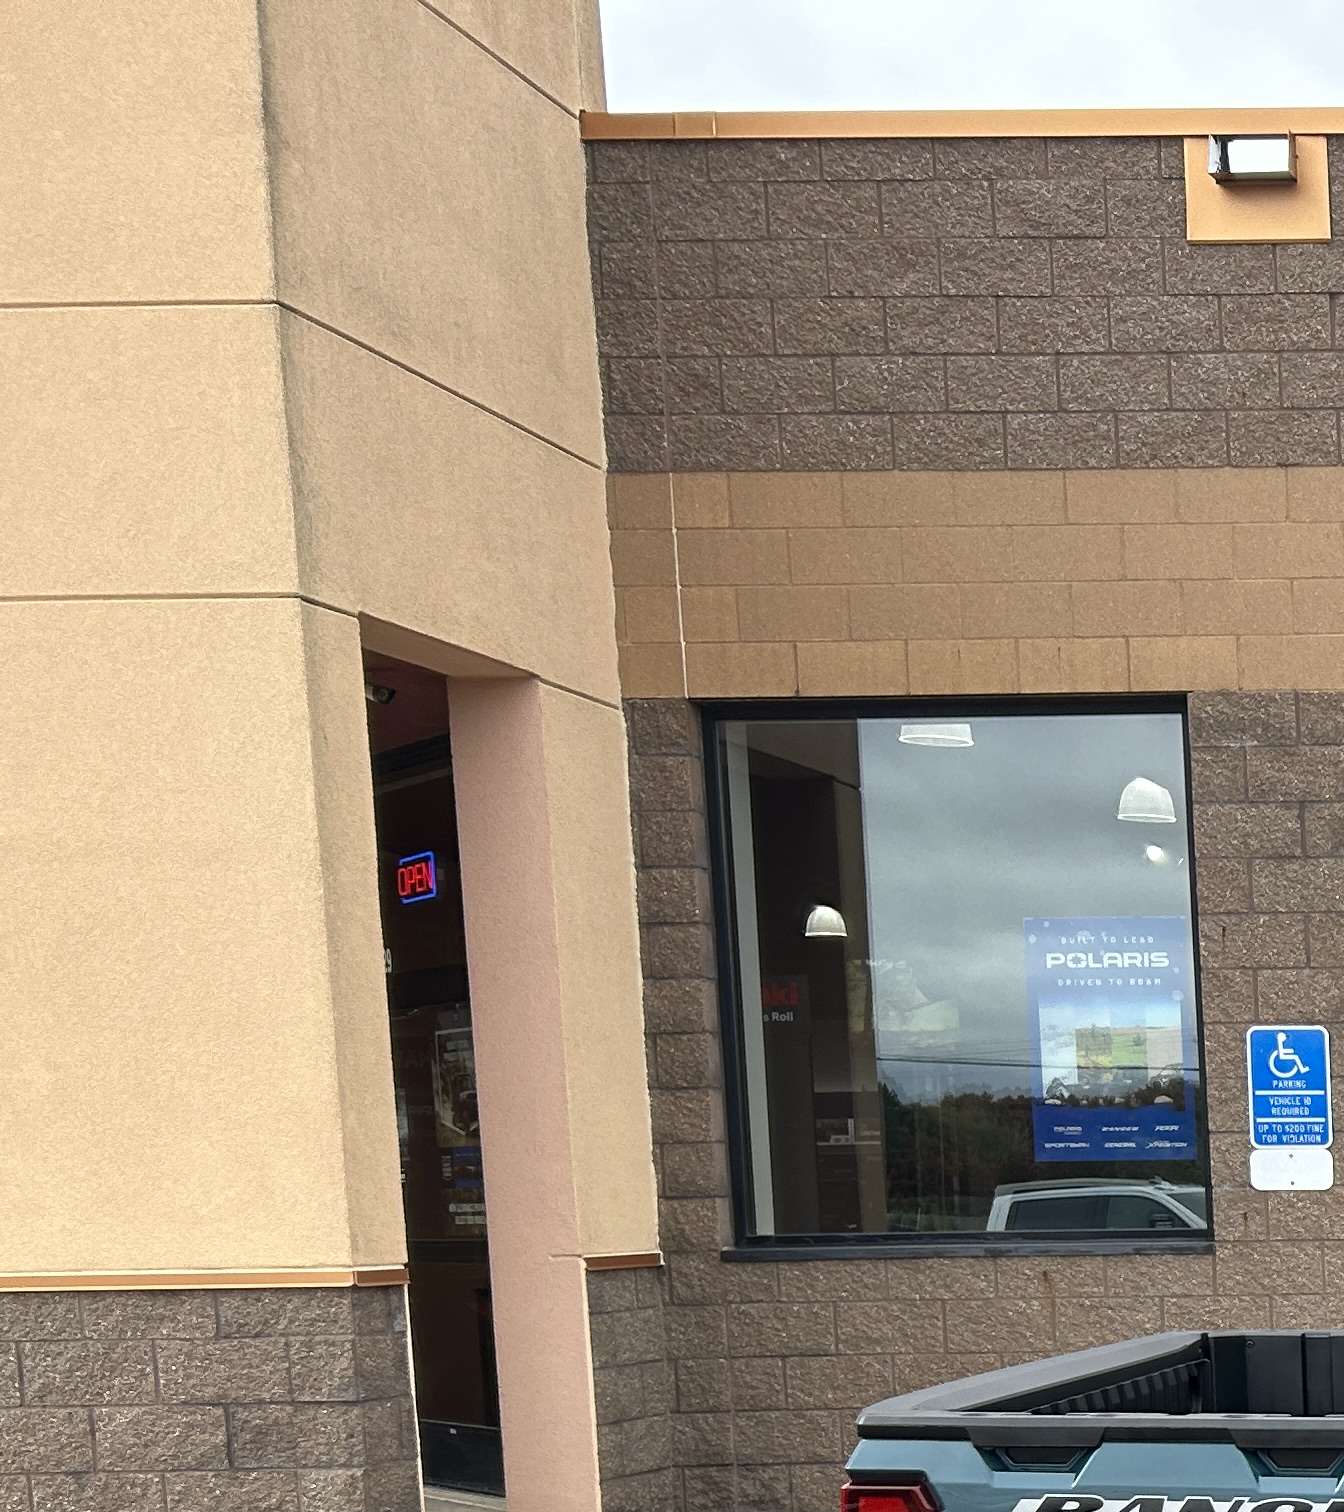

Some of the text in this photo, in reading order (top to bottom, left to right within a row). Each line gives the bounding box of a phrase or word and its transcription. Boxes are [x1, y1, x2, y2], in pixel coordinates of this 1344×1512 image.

[398, 861, 433, 896] OPEN
[1060, 935, 1096, 945] BUILT
[1102, 935, 1117, 945] TO
[1045, 951, 1170, 969] POLARIS
[1057, 977, 1162, 987] DRIVEN TO ROAM
[771, 1011, 794, 1022] Roll
[1272, 1079, 1307, 1089] PARKING
[1268, 1096, 1312, 1106] VEHICLE ID
[1271, 1106, 1310, 1116] REQUIRED
[1258, 1124, 1325, 1133] UP TO $200 FINE
[1262, 1134, 1322, 1144] FOR VIOLATION
